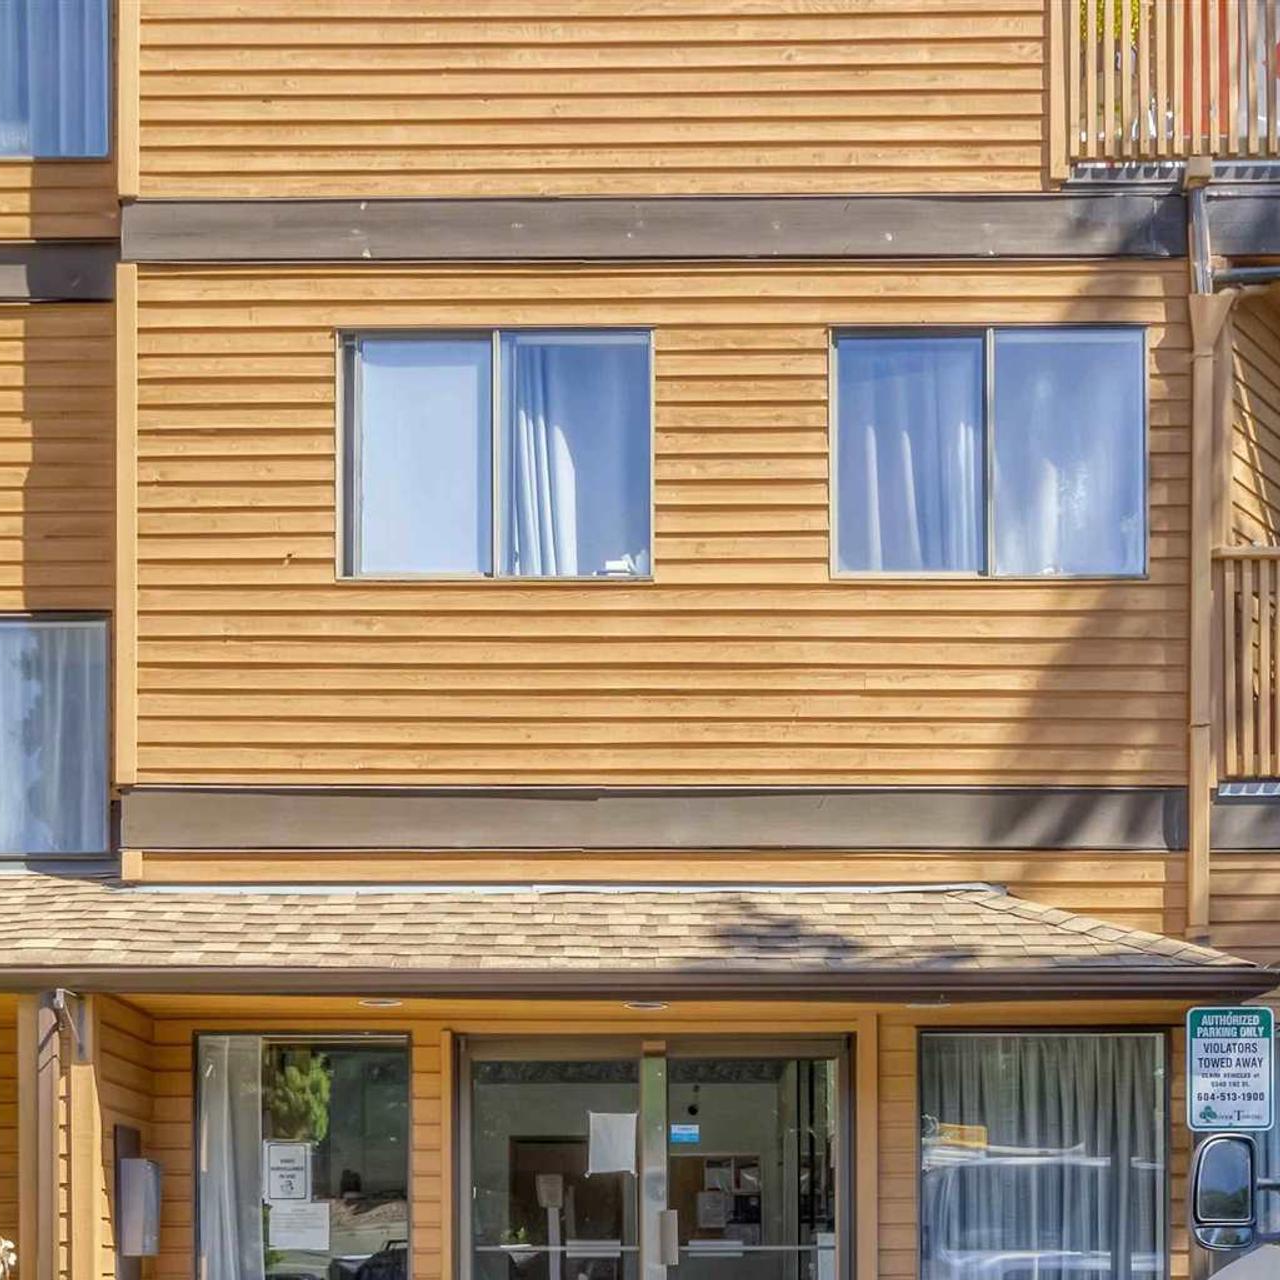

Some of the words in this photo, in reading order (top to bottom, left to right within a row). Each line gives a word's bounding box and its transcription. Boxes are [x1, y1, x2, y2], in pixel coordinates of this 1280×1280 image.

[1201, 1014, 1260, 1026] AUTHORIZED
[1197, 1026, 1238, 1038] PARKING
[1240, 1026, 1265, 1038] ONLY
[1203, 1042, 1258, 1054] VIOLATORS
[1198, 1057, 1233, 1069] TOWED
[1235, 1057, 1264, 1069] AWAY
